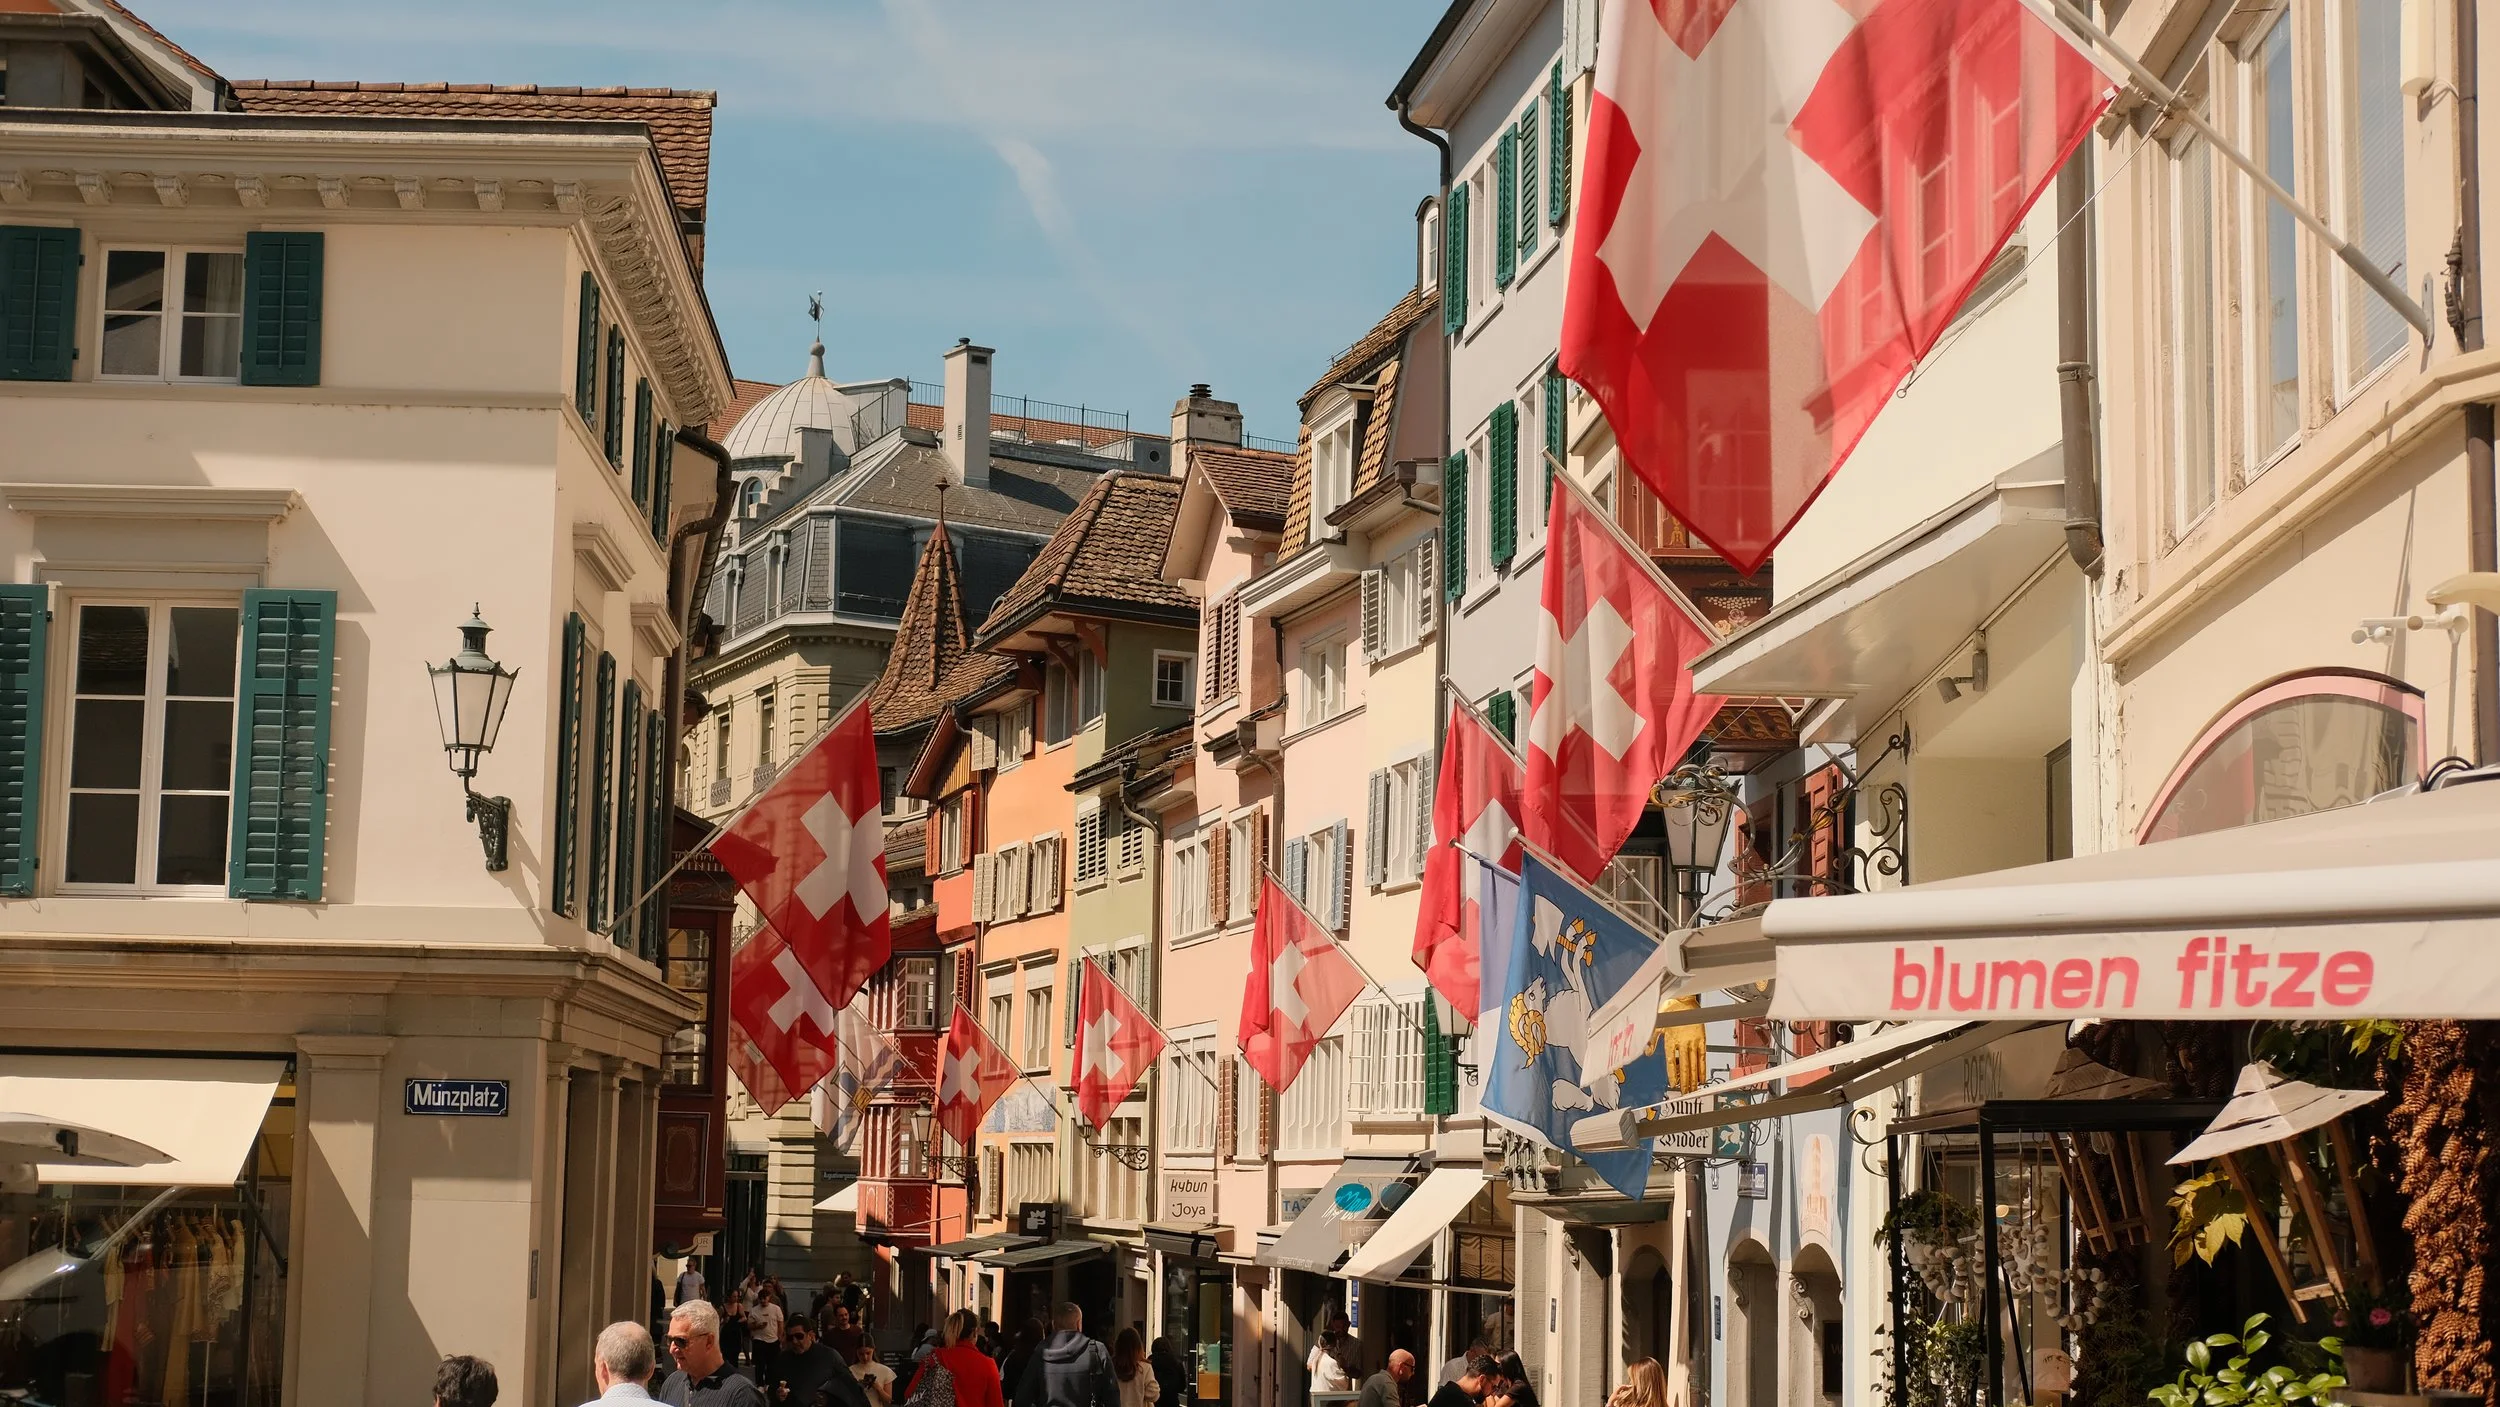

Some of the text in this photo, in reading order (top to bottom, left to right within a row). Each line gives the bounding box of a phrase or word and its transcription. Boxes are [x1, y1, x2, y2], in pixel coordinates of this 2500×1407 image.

[1889, 936, 2375, 1011] blumen fitze
[413, 1083, 499, 1112] Münzplatz
[1170, 1179, 1208, 1192] kybun
[1171, 1202, 1206, 1218] Joya
